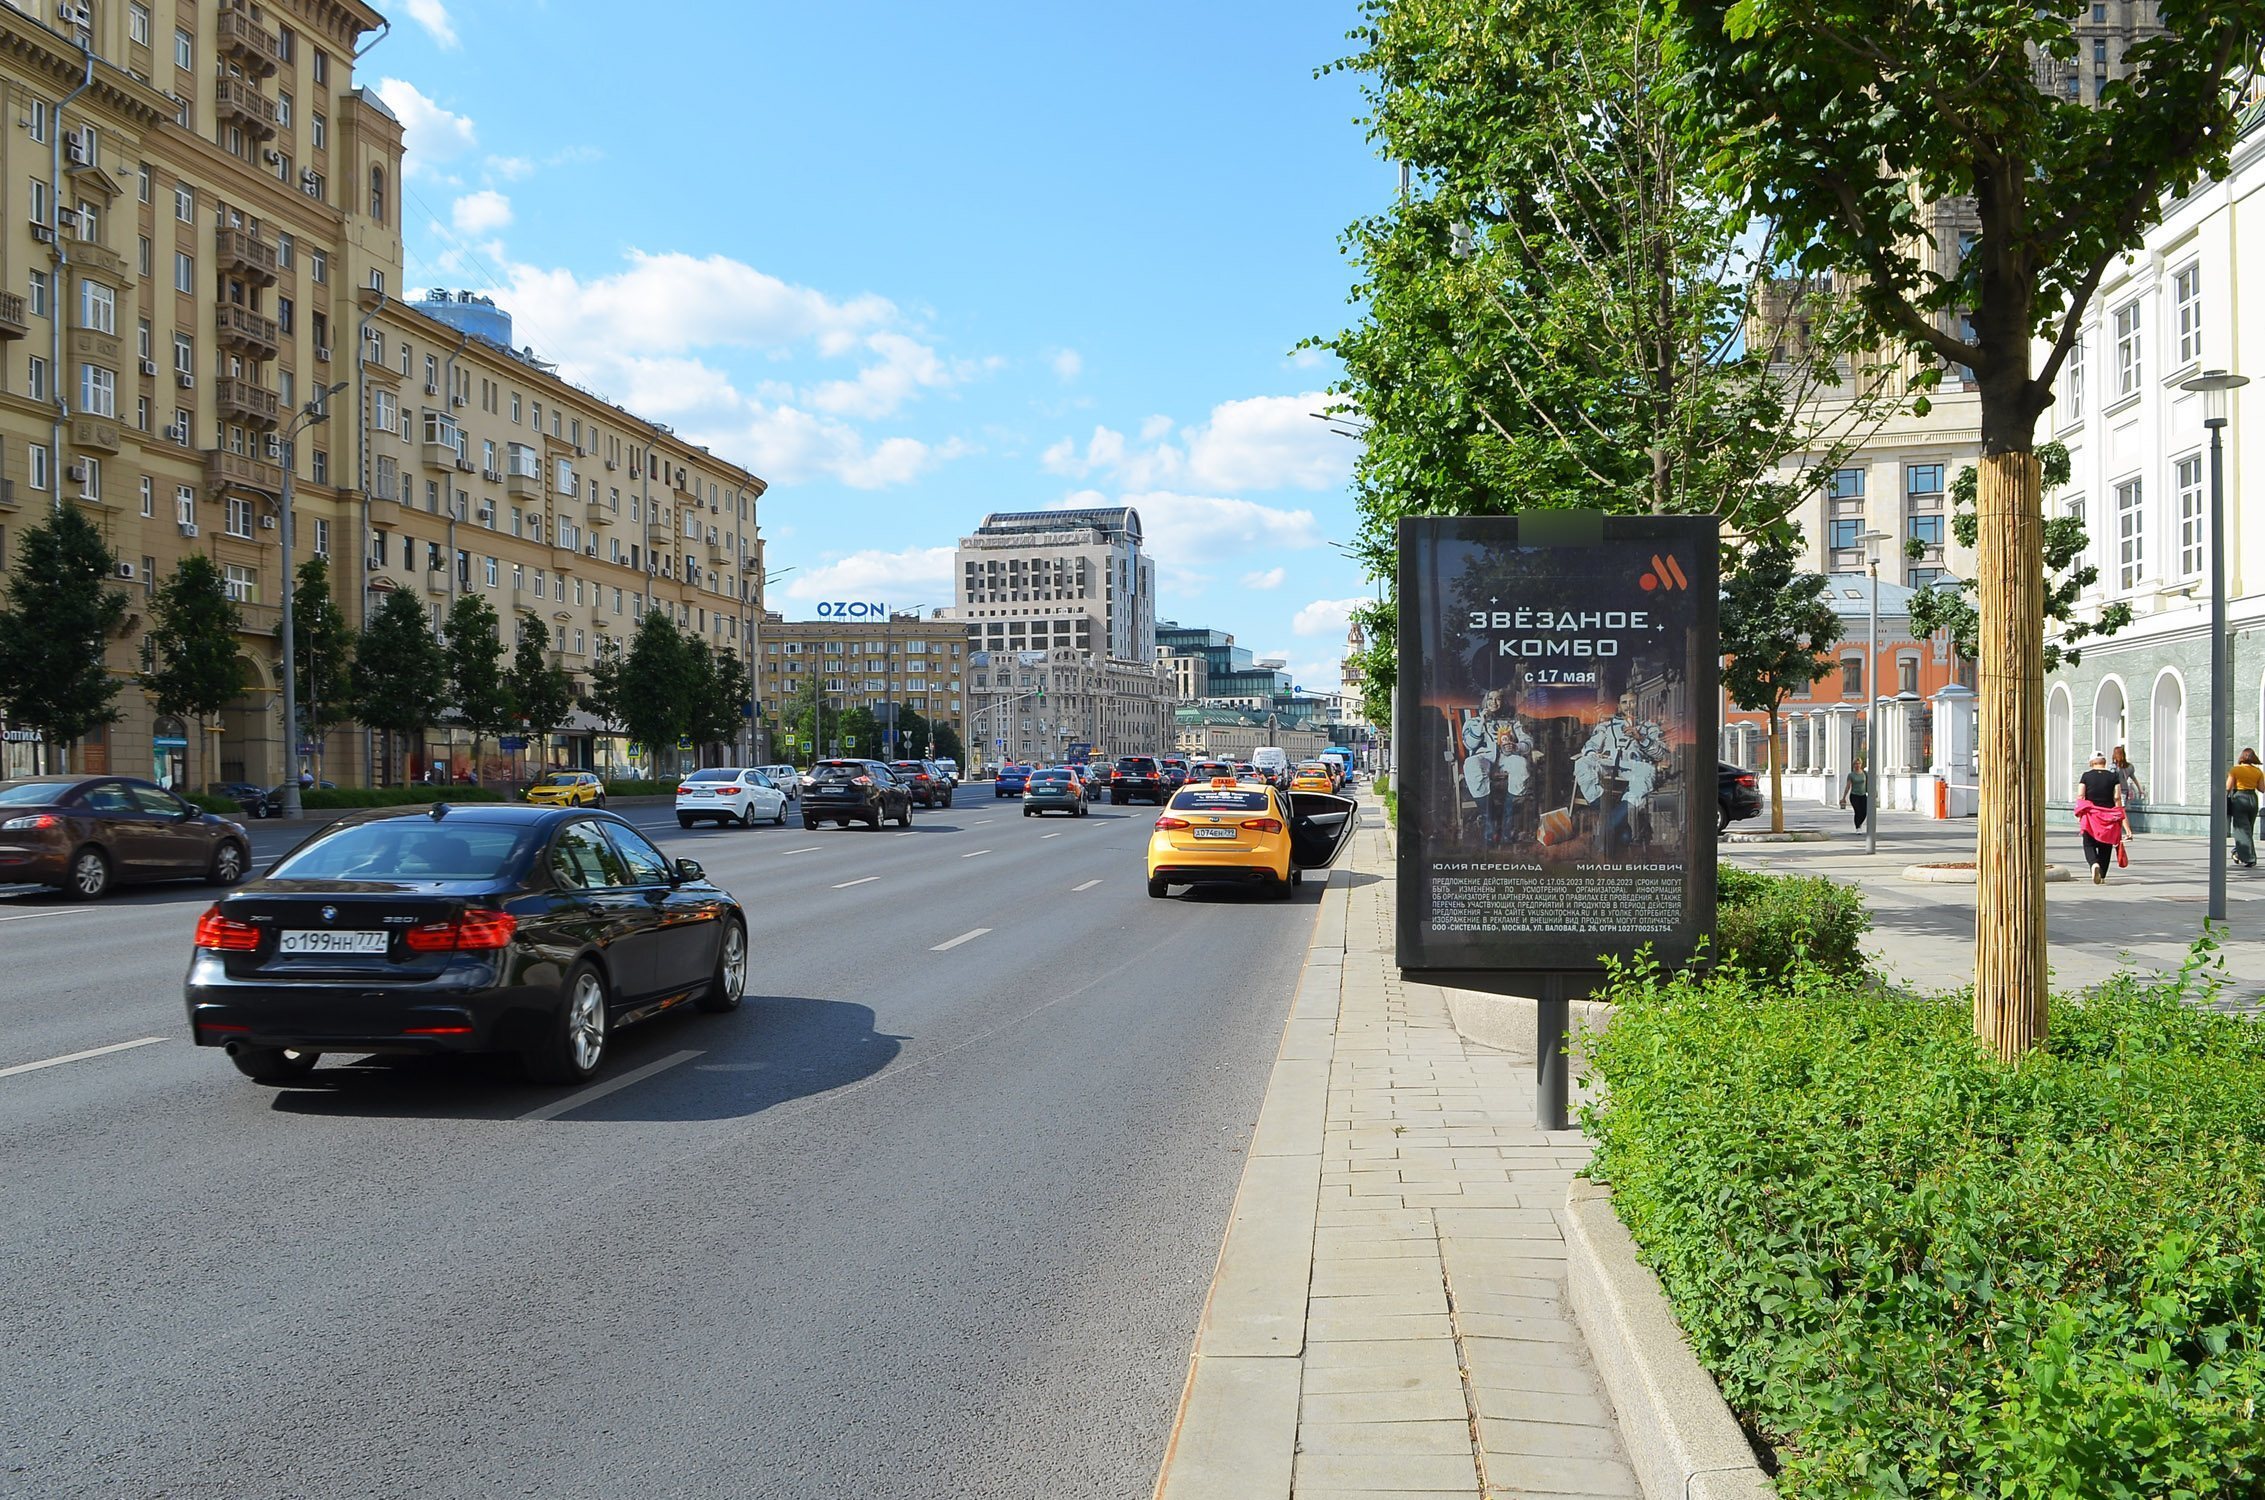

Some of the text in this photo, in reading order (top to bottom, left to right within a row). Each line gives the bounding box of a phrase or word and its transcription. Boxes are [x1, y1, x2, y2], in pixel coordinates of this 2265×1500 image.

[817, 602, 884, 616] OZON
[1469, 607, 1648, 631] ЗВЁЗДНОЕ
[1500, 640, 1618, 656] КОМБО
[1524, 670, 1596, 682] с 17 мая
[2, 730, 42, 742] ОПТИКА
[1483, 877, 1537, 886] ДЕЙСТВИТЕЛЬНО
[1518, 900, 1564, 909] ПРЕДПРИЯТИЙ
[1648, 900, 1682, 909] ДЕЙСТВИЯ
[1580, 925, 1586, 933] Д.
[286, 932, 382, 950] О199НН 777
